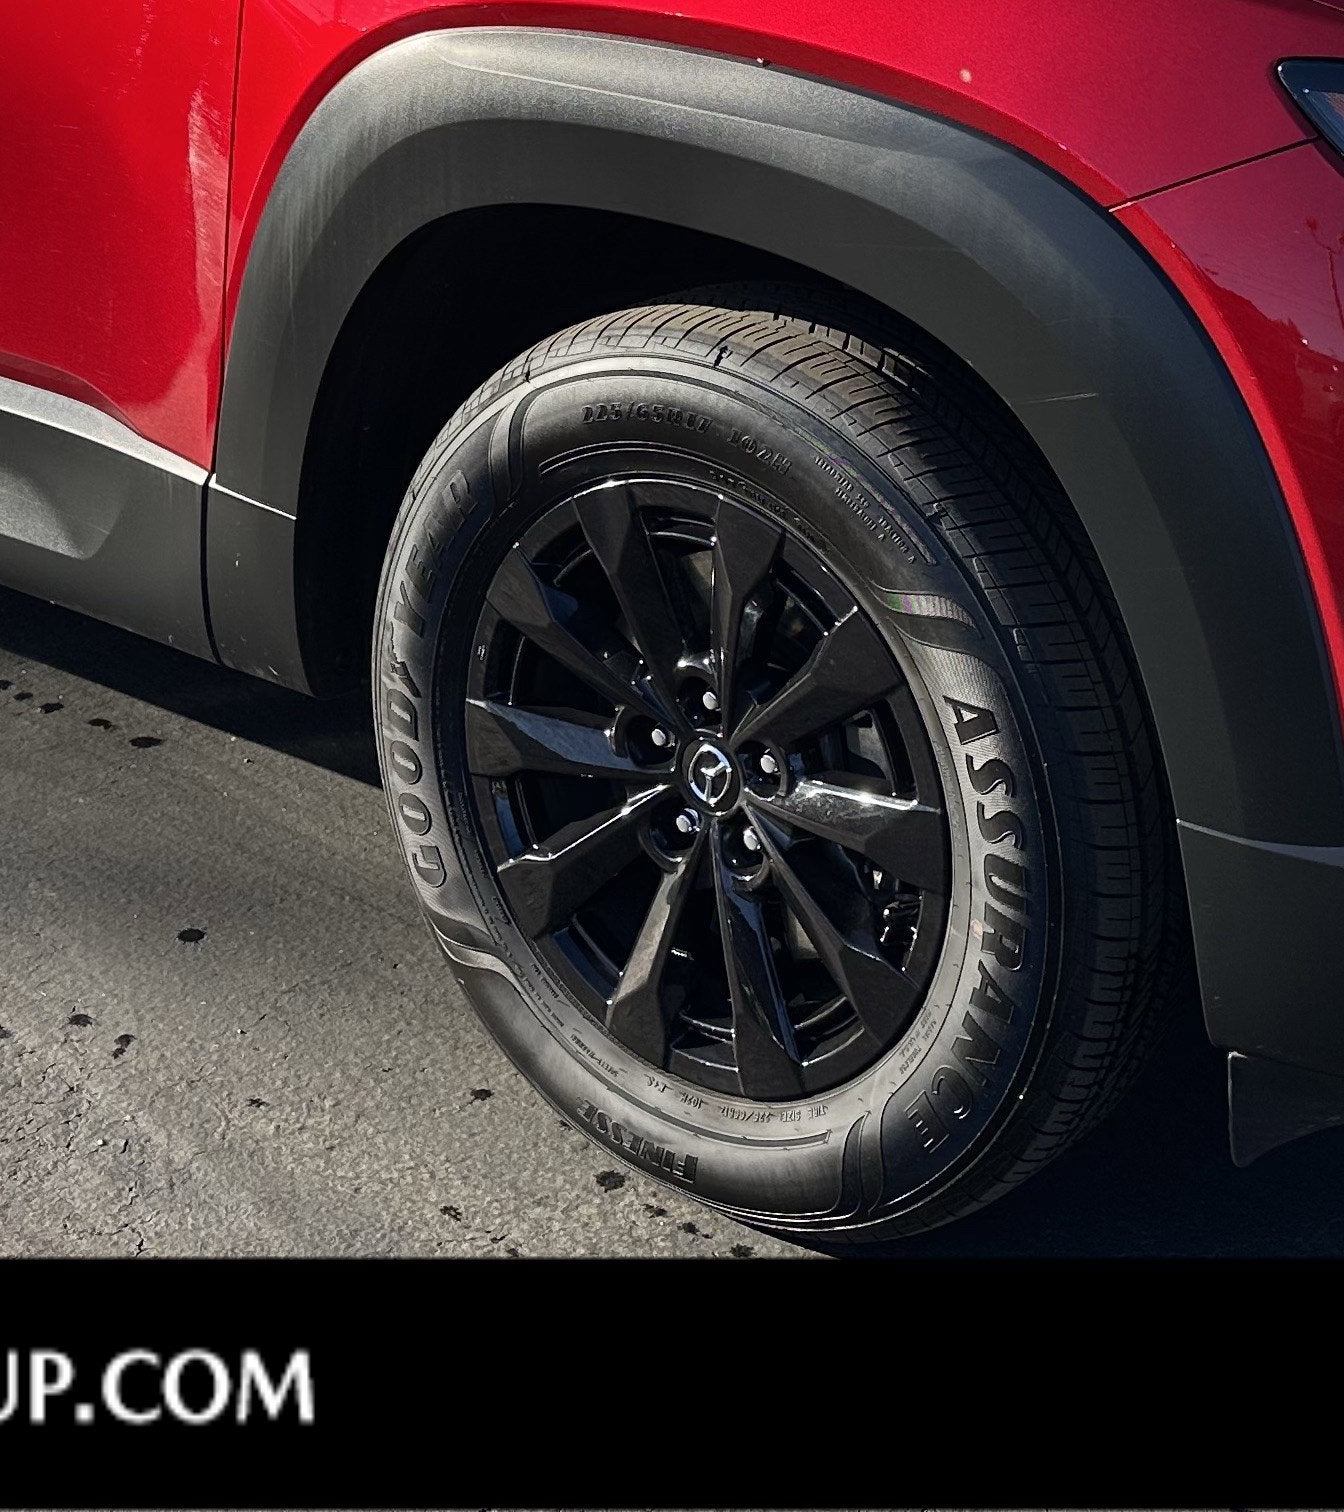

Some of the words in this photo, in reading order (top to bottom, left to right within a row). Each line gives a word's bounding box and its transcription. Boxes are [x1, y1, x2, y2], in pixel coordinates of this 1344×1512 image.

[387, 468, 480, 888] GOODYEAR
[904, 695, 1028, 1154] ASSURANCE
[576, 1096, 699, 1184] FINESSE
